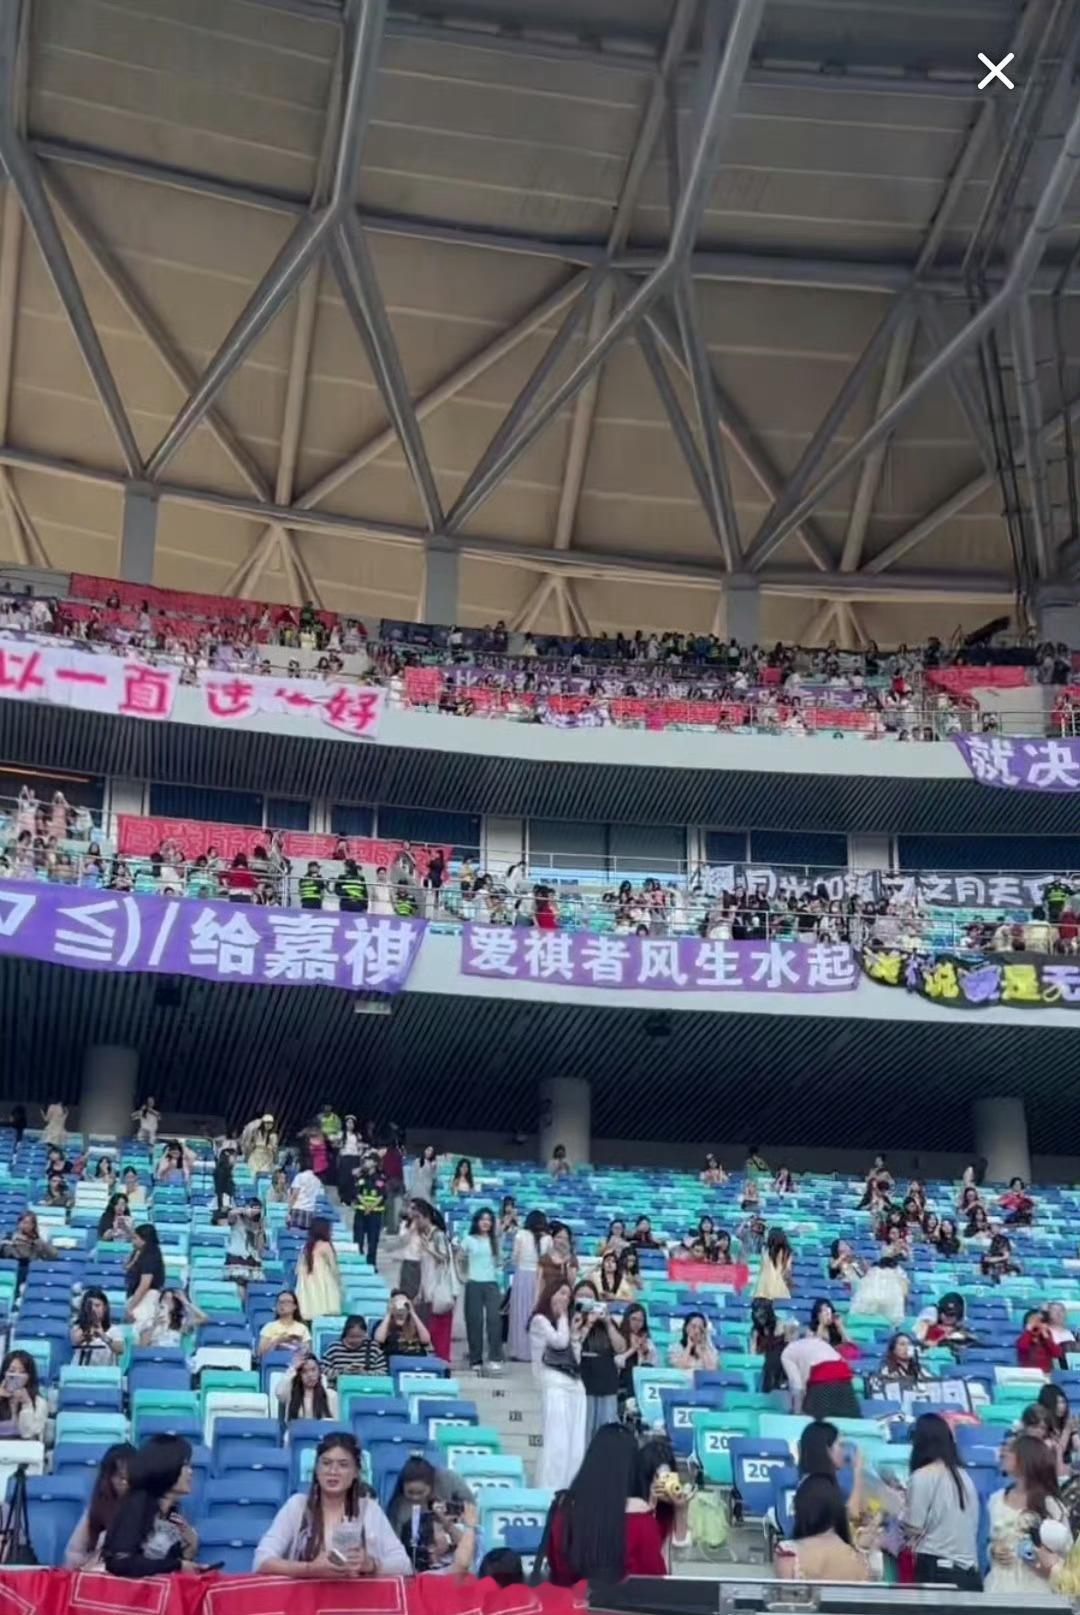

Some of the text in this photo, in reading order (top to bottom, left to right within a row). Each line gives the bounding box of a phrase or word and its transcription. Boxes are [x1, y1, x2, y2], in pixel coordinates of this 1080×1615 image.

[965, 733, 1080, 789] 就决
[189, 907, 418, 987] 给嘉祺
[467, 925, 856, 989] 爱祺者风生水起
